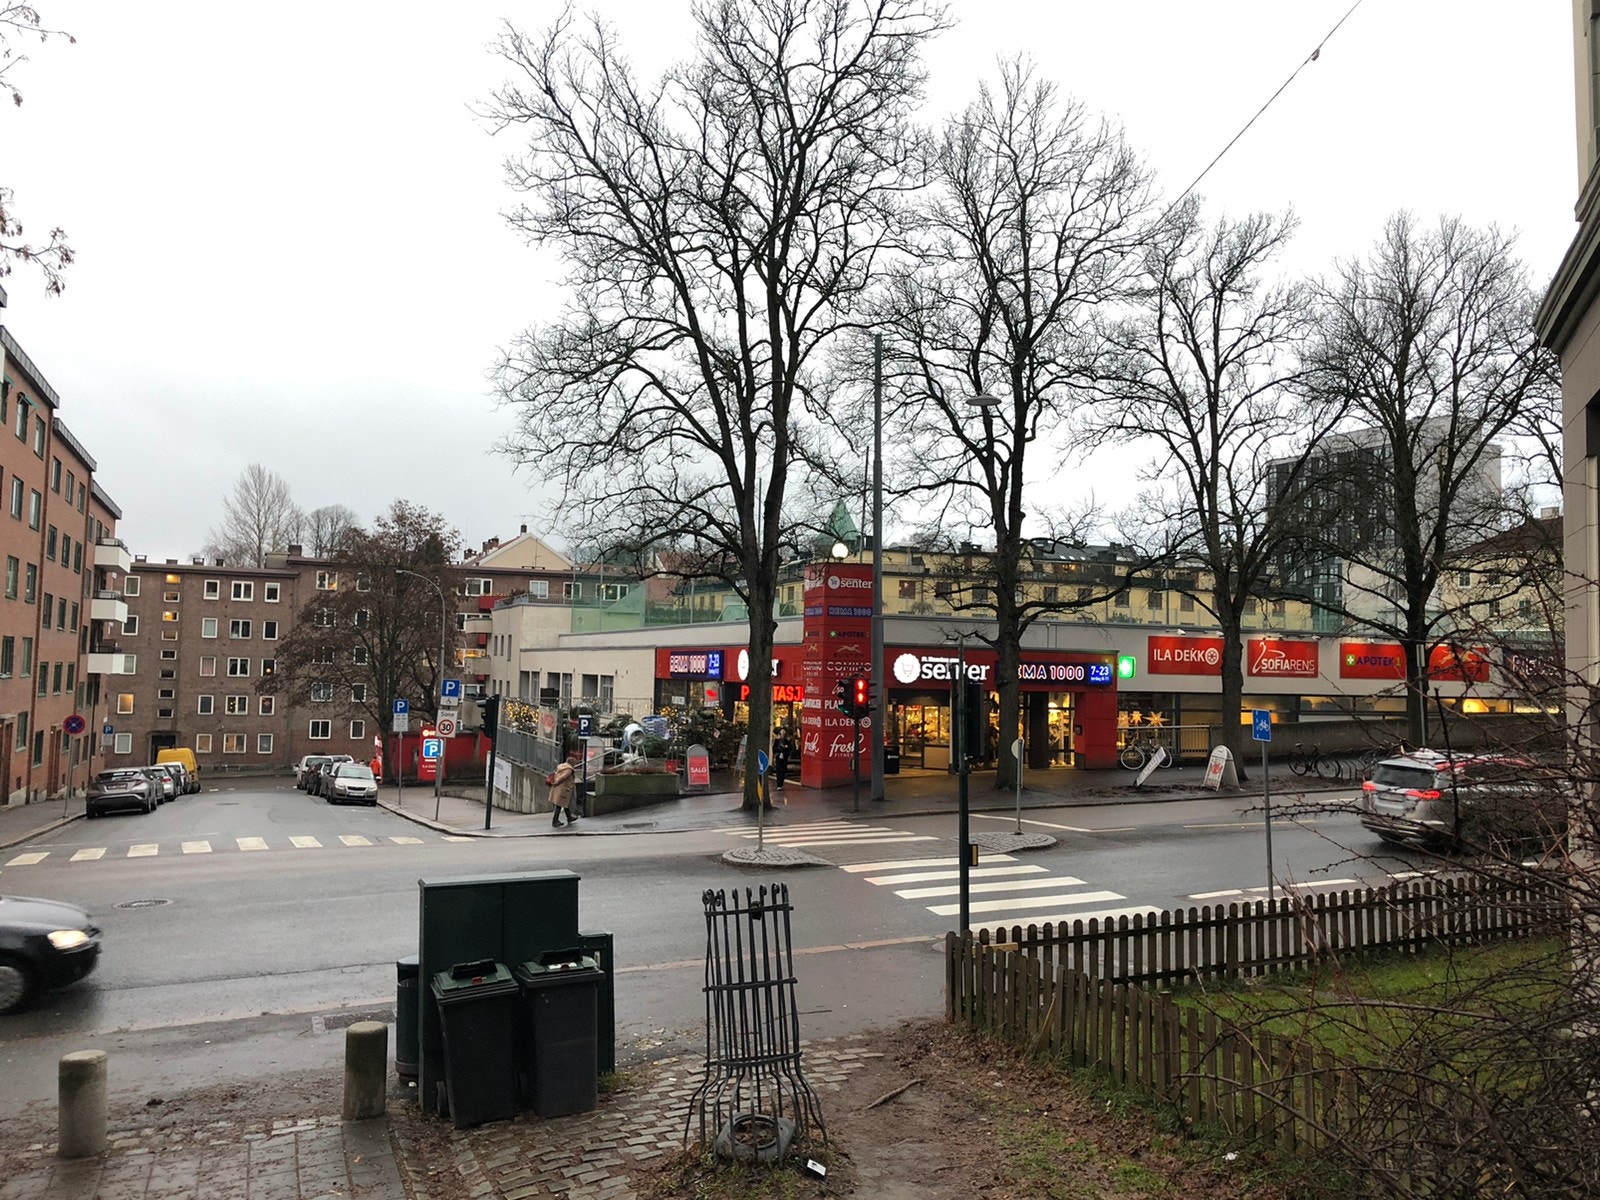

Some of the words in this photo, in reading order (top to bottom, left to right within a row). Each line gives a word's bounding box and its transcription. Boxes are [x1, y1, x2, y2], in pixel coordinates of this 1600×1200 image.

[840, 579, 873, 589] senter
[1153, 648, 1172, 661] ILA
[669, 655, 689, 673] REMA
[689, 655, 706, 674] 1000
[1261, 658, 1315, 671] SOFIARENS
[1357, 656, 1394, 667] APOTEK
[1050, 665, 1085, 681] 1000
[1090, 665, 1110, 677] 7-23
[445, 681, 456, 694] P
[396, 701, 405, 712] P
[580, 719, 589, 730] P
[824, 718, 838, 727] ILA
[429, 745, 438, 756] P
